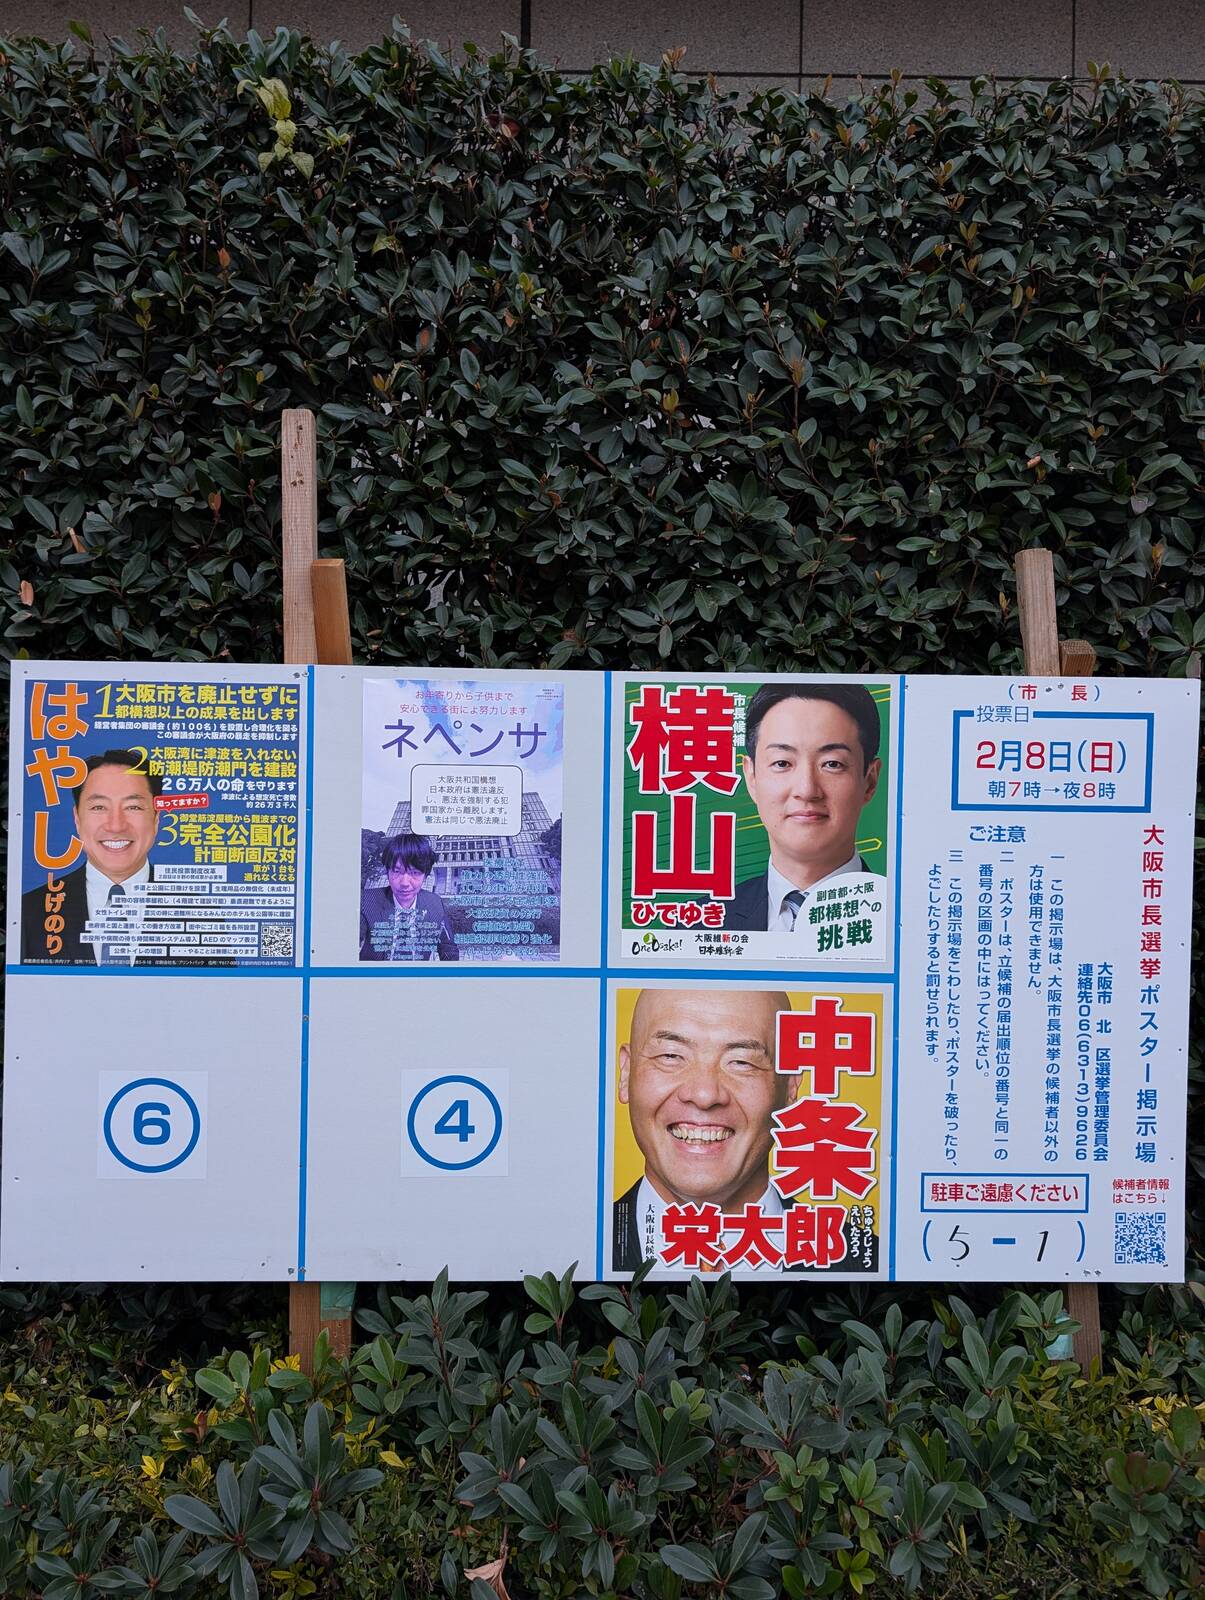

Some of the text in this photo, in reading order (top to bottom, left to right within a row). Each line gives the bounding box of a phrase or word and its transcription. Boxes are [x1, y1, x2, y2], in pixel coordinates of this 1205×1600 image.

[94, 684, 298, 718] 1 大阪市を廃止せずに
[415, 690, 514, 702] お年寄りから子供まで
[115, 705, 298, 721] 都構想以上の成果を出します
[733, 693, 746, 747] 市長候補
[976, 705, 1030, 724] 投票日
[382, 718, 548, 758] ネペンサ
[123, 746, 296, 775] 2 大阪湾に津波を入れない
[149, 760, 297, 777] 防潮堤防潮門を建設
[976, 740, 1127, 774] 2月8日(日)
[438, 776, 497, 784] 大阪共和国構想
[629, 686, 740, 898] 横山
[26, 682, 88, 955] はやし しげのり
[158, 813, 178, 846] 3
[179, 824, 296, 846] 完全公園化
[969, 825, 1026, 843] ご注意
[194, 847, 296, 864] 計画断固反対
[816, 882, 874, 902] 副首都・大阪
[632, 902, 724, 928] ひでゆき
[808, 900, 882, 925] 都構想への
[694, 934, 749, 944] 大阪維新の会
[816, 920, 873, 953] 挑戦
[1027, 864, 1044, 996] 方は使用できません。
[925, 864, 942, 1063] よごしたりすると罰せられます。
[975, 864, 994, 1078] 番号の区画の中にはってください。
[772, 997, 878, 1199] 中条
[133, 1101, 171, 1146] 6
[434, 1100, 475, 1142] 4
[930, 1182, 1080, 1202] 駐車ご遠慮ください
[1112, 1178, 1170, 1190] 候補者情報
[660, 1202, 847, 1270] 栄太郎
[850, 1206, 861, 1258] えいたろう
[864, 1205, 874, 1268] ちゅうじょう
